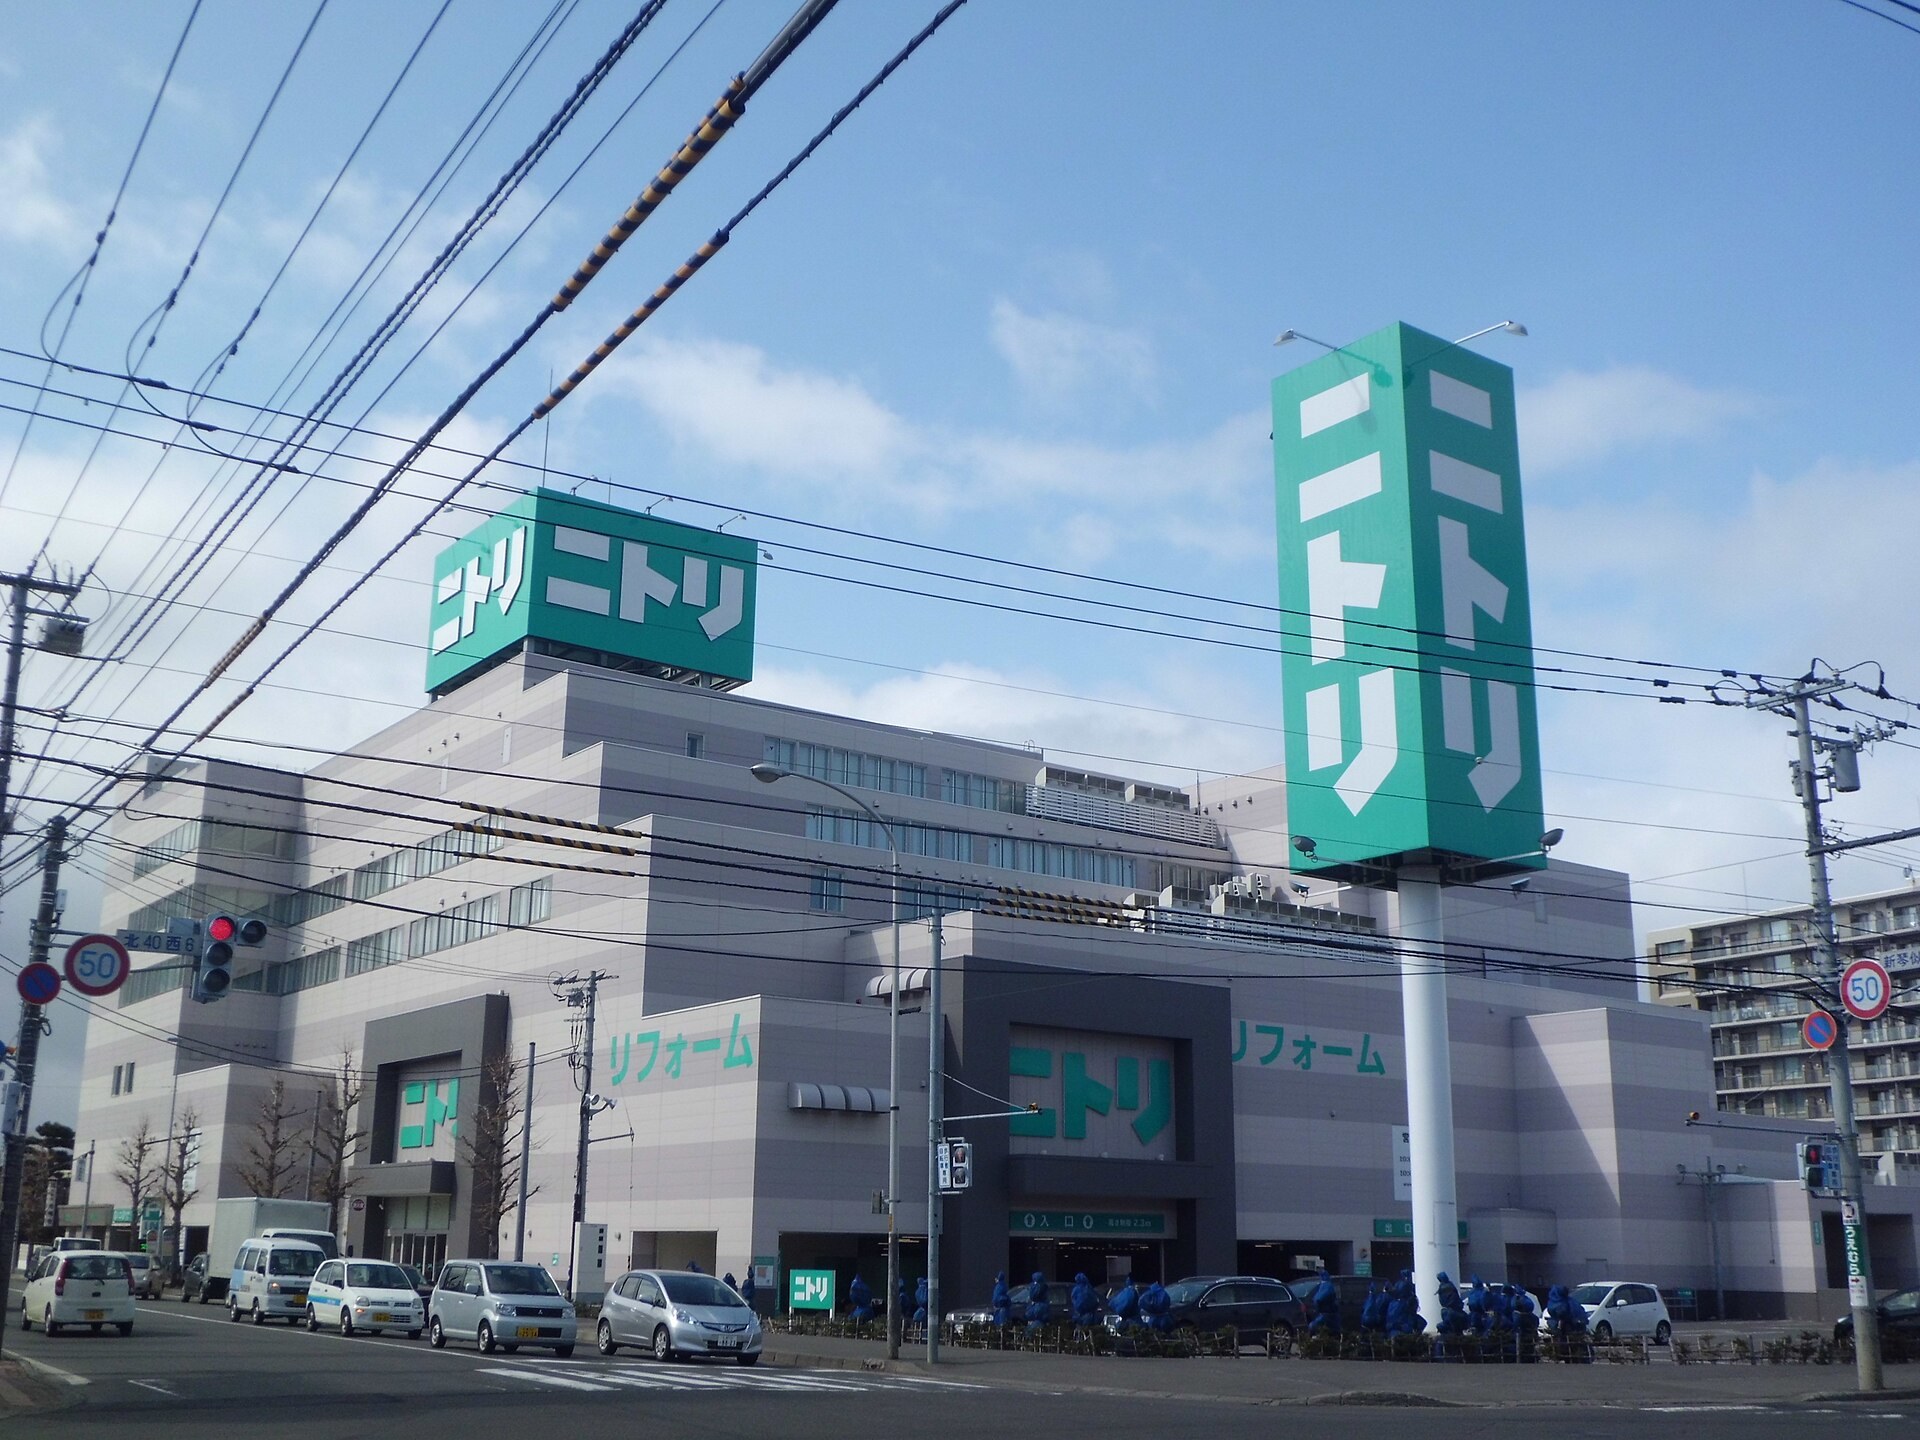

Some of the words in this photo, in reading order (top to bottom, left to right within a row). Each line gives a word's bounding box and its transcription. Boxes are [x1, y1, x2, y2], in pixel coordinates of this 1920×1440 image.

[432, 525, 527, 656] ニトリ
[545, 525, 745, 642] ニトリ
[1299, 371, 1398, 817] ニトリ
[1428, 369, 1522, 814] ニトリ
[78, 950, 116, 980] 50
[1851, 976, 1879, 1003] 50
[610, 1013, 753, 1086] リフォーム
[1009, 1047, 1172, 1145] ニトリ
[794, 1276, 828, 1302] ニトリ
[1845, 1226, 1860, 1275] うえむら
